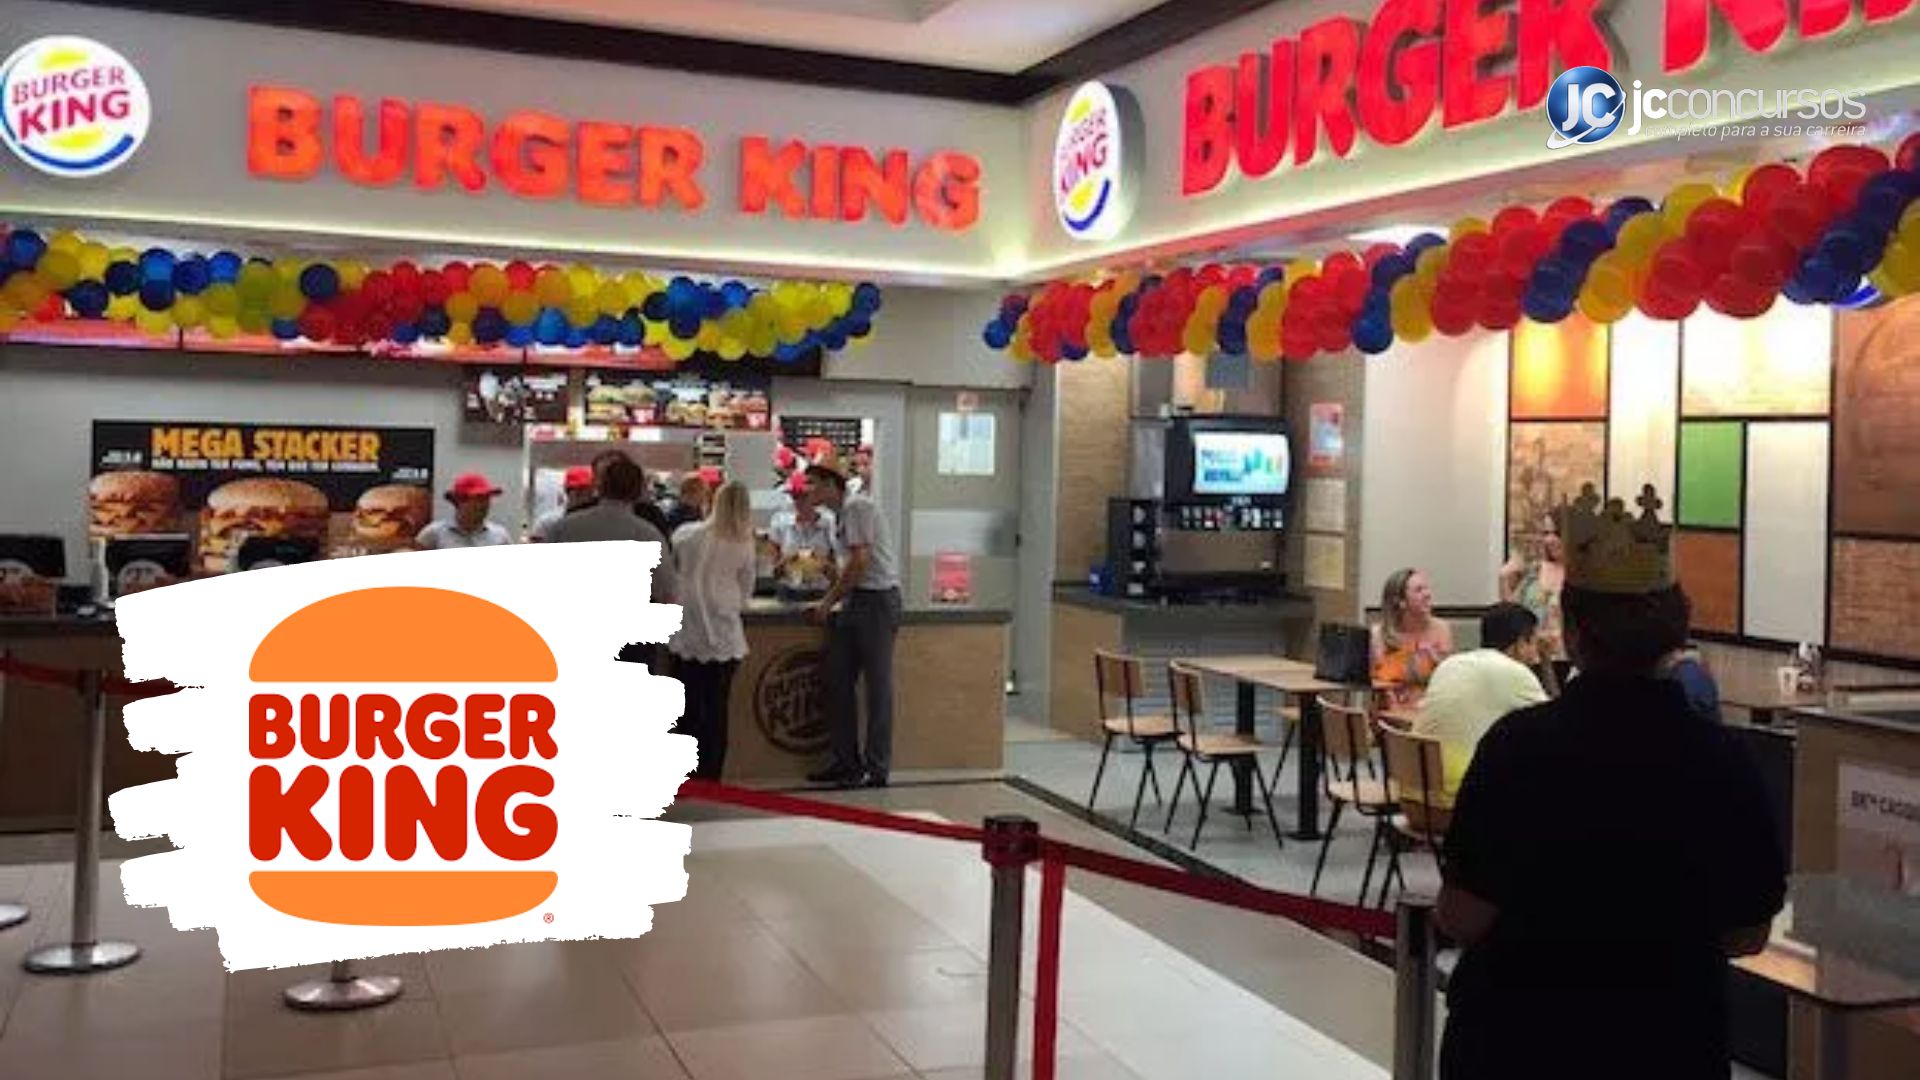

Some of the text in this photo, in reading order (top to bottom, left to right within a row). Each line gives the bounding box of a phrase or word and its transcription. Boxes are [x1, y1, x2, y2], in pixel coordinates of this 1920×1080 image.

[12, 65, 126, 105] BURGER
[19, 90, 130, 140] KING
[247, 85, 982, 231] BURGER KING
[152, 428, 242, 458] MEGA
[253, 432, 379, 460] STACKER
